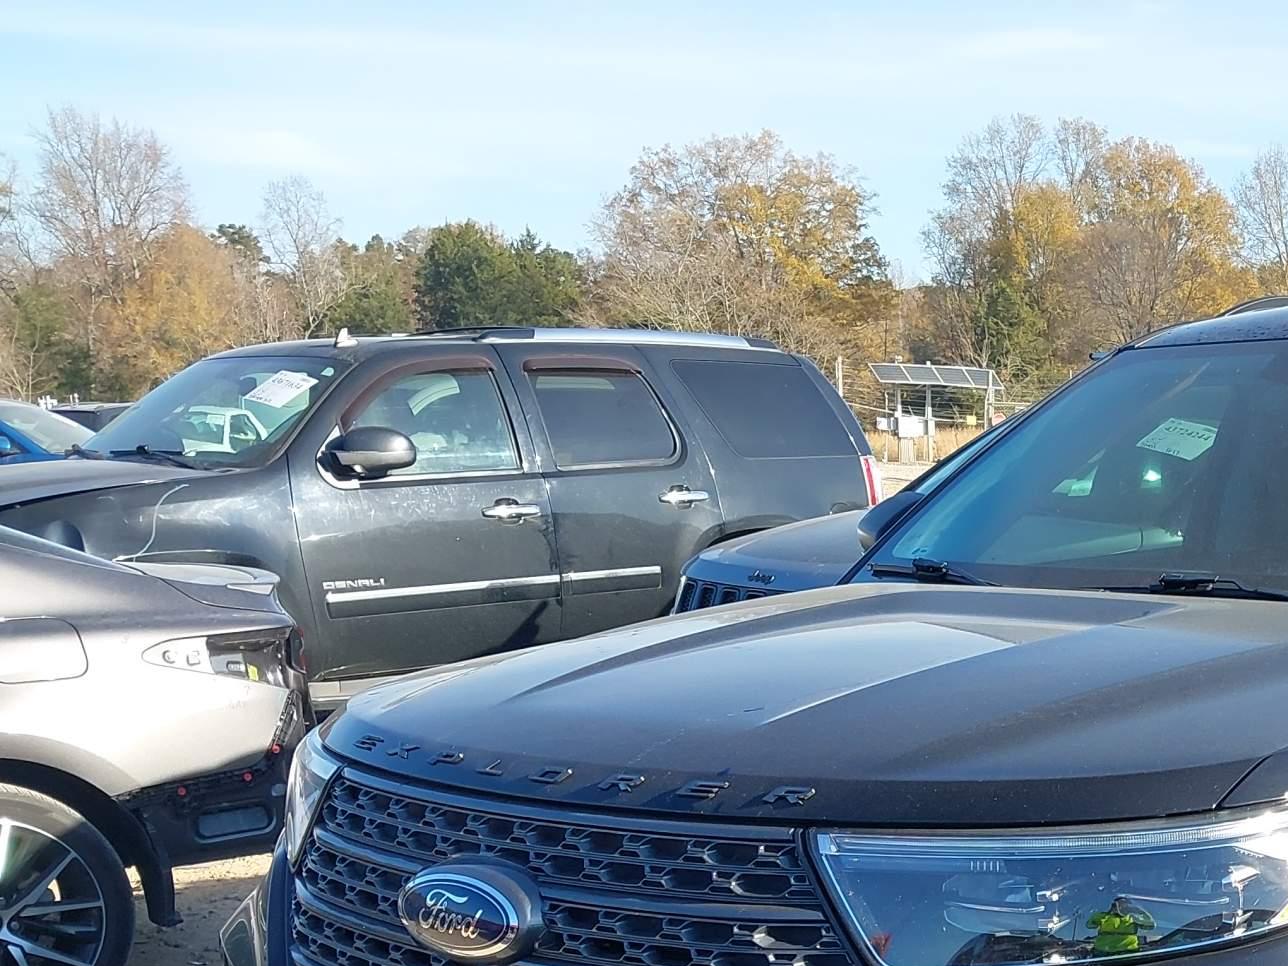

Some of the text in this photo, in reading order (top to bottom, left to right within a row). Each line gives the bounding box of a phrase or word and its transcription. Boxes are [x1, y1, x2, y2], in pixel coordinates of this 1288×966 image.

[322, 578, 385, 590] DENALI
[353, 733, 817, 807] EXPLORER
[419, 888, 484, 939] Ford
